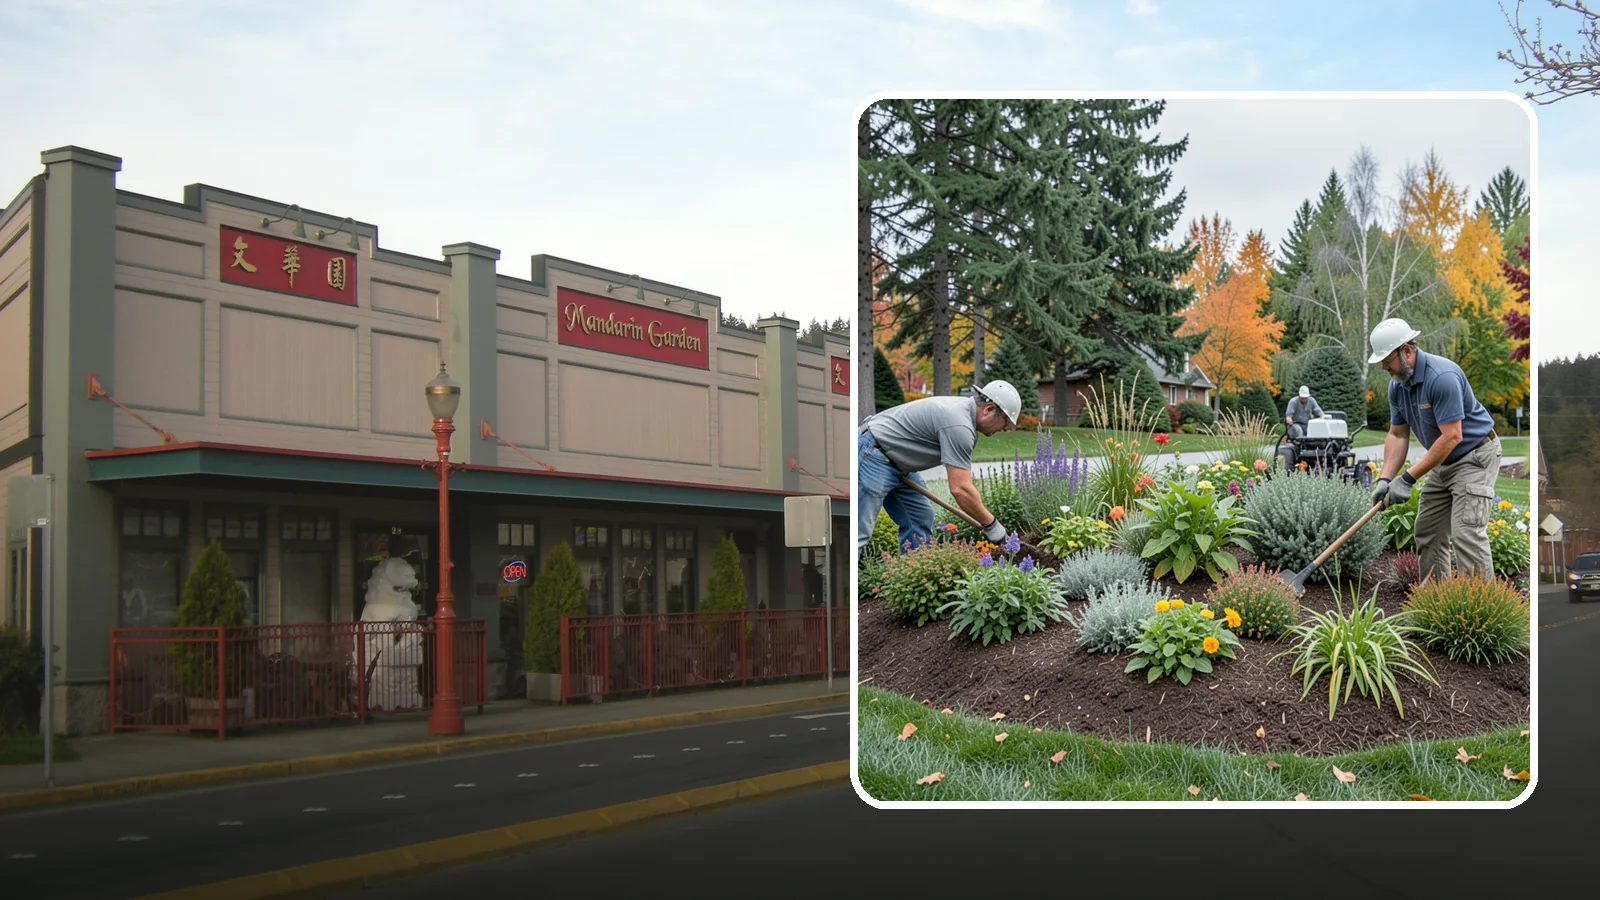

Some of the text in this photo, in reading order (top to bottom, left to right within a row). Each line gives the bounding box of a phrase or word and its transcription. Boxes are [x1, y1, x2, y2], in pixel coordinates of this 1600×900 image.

[231, 235, 346, 291] 文華園
[564, 302, 702, 352] Mandarin Garden
[503, 565, 527, 578] OPEN
